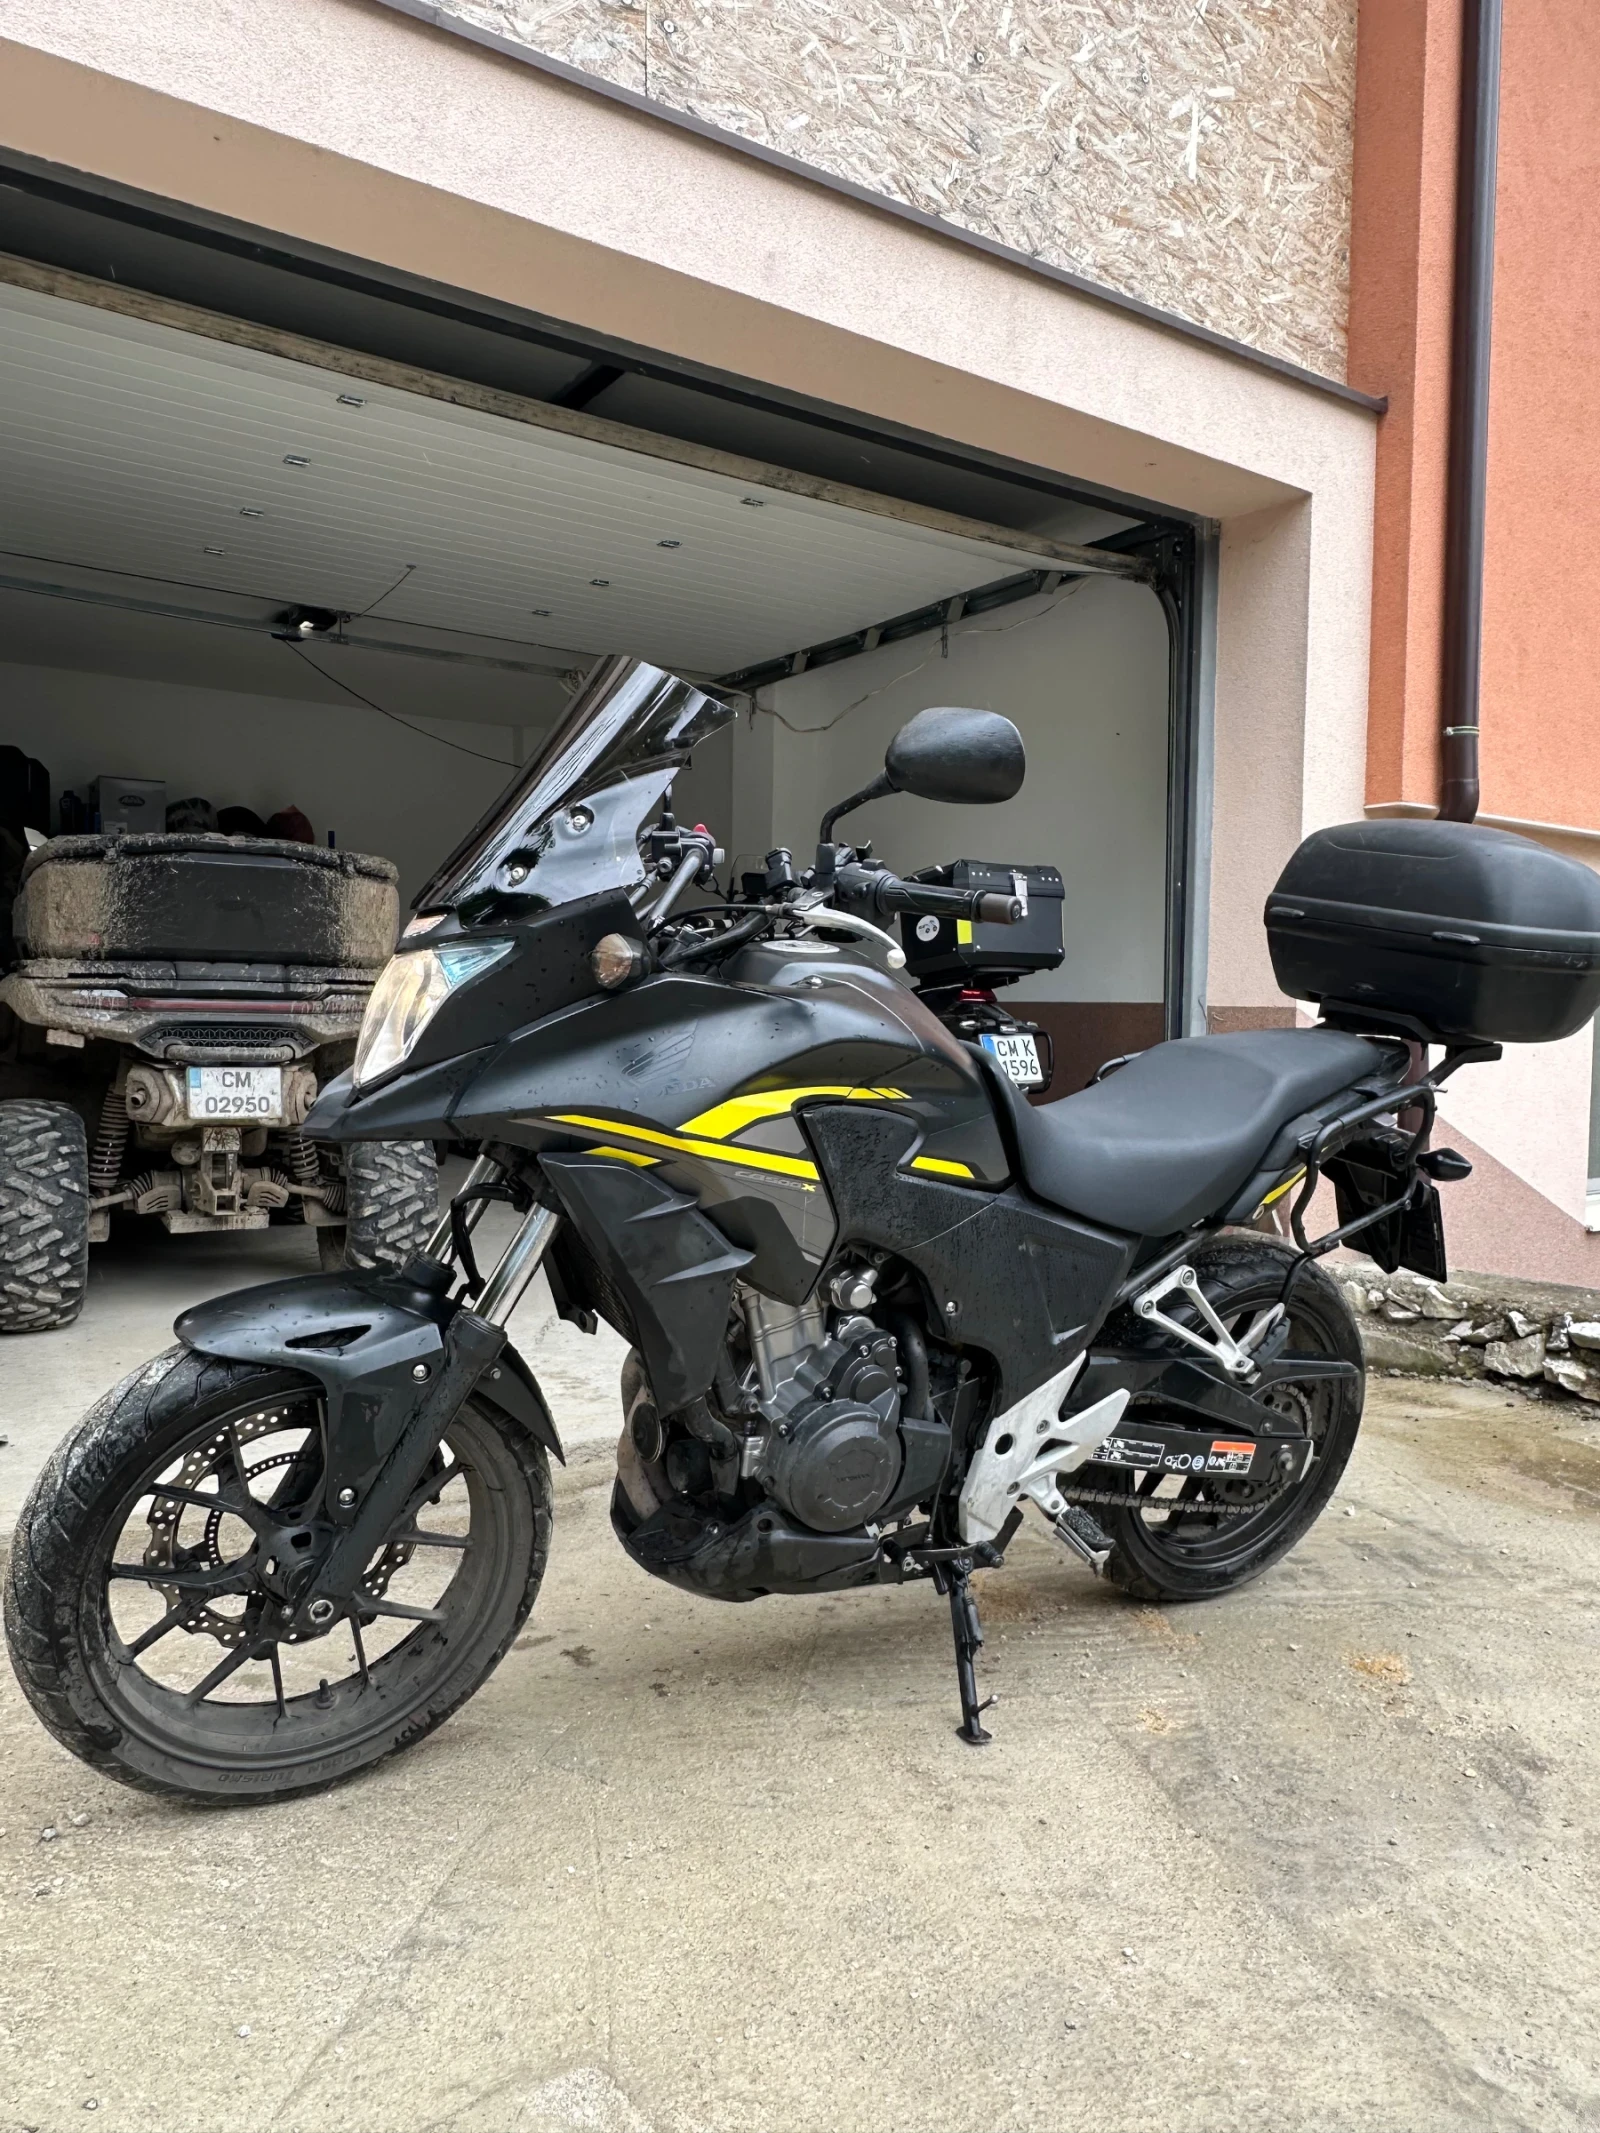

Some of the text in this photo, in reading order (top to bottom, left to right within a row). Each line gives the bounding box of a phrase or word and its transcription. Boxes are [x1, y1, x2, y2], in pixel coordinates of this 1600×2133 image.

[997, 1039, 1034, 1057] CM K
[1002, 1059, 1038, 1076] 1596
[222, 1071, 251, 1088] CM
[205, 1096, 270, 1114] 02950
